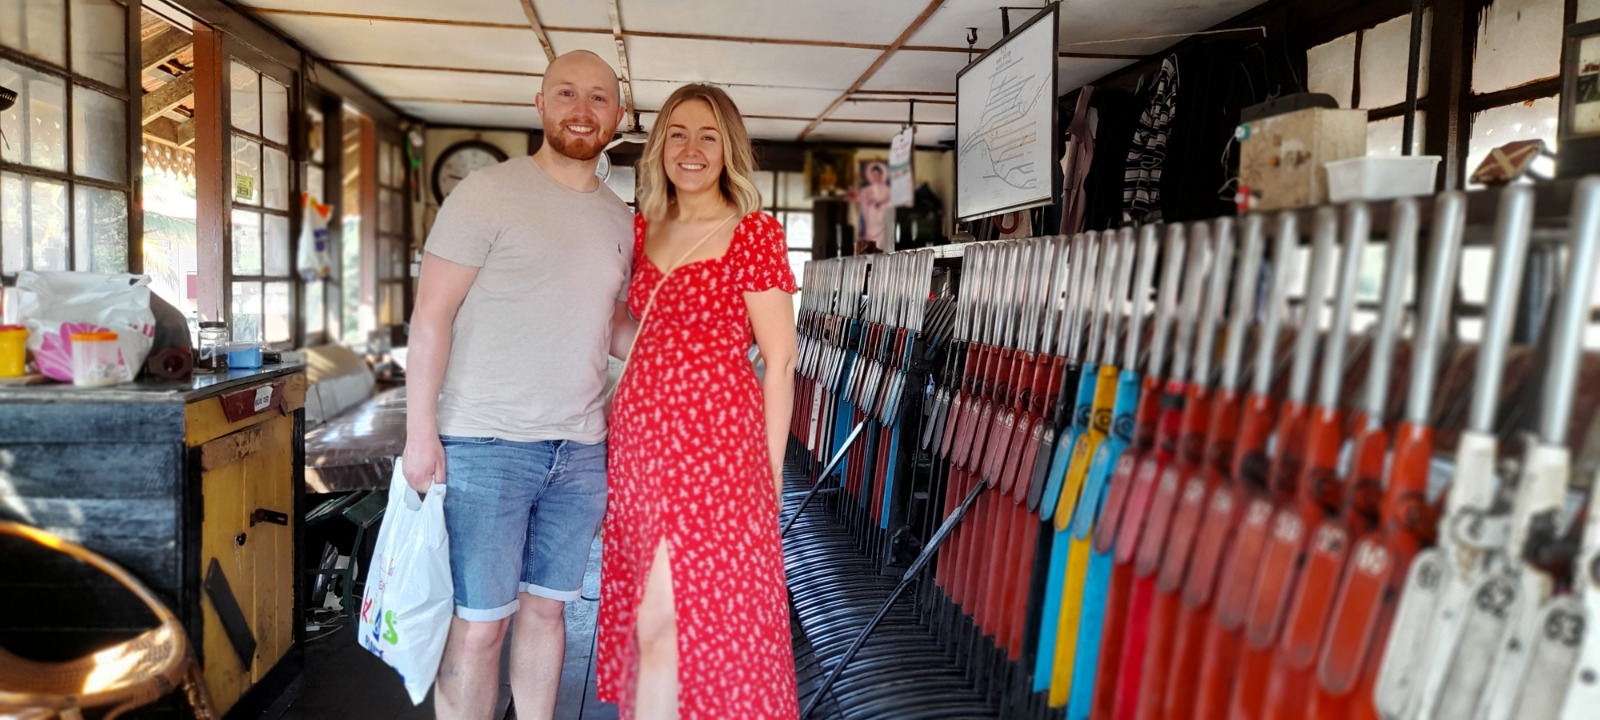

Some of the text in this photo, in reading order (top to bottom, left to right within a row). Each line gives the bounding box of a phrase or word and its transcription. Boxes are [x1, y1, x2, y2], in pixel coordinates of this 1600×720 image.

[1005, 412, 1014, 427] 45
[1033, 424, 1043, 438] 47
[1043, 428, 1054, 443] 48
[1476, 576, 1515, 619] 62
[1544, 607, 1586, 648] 63
